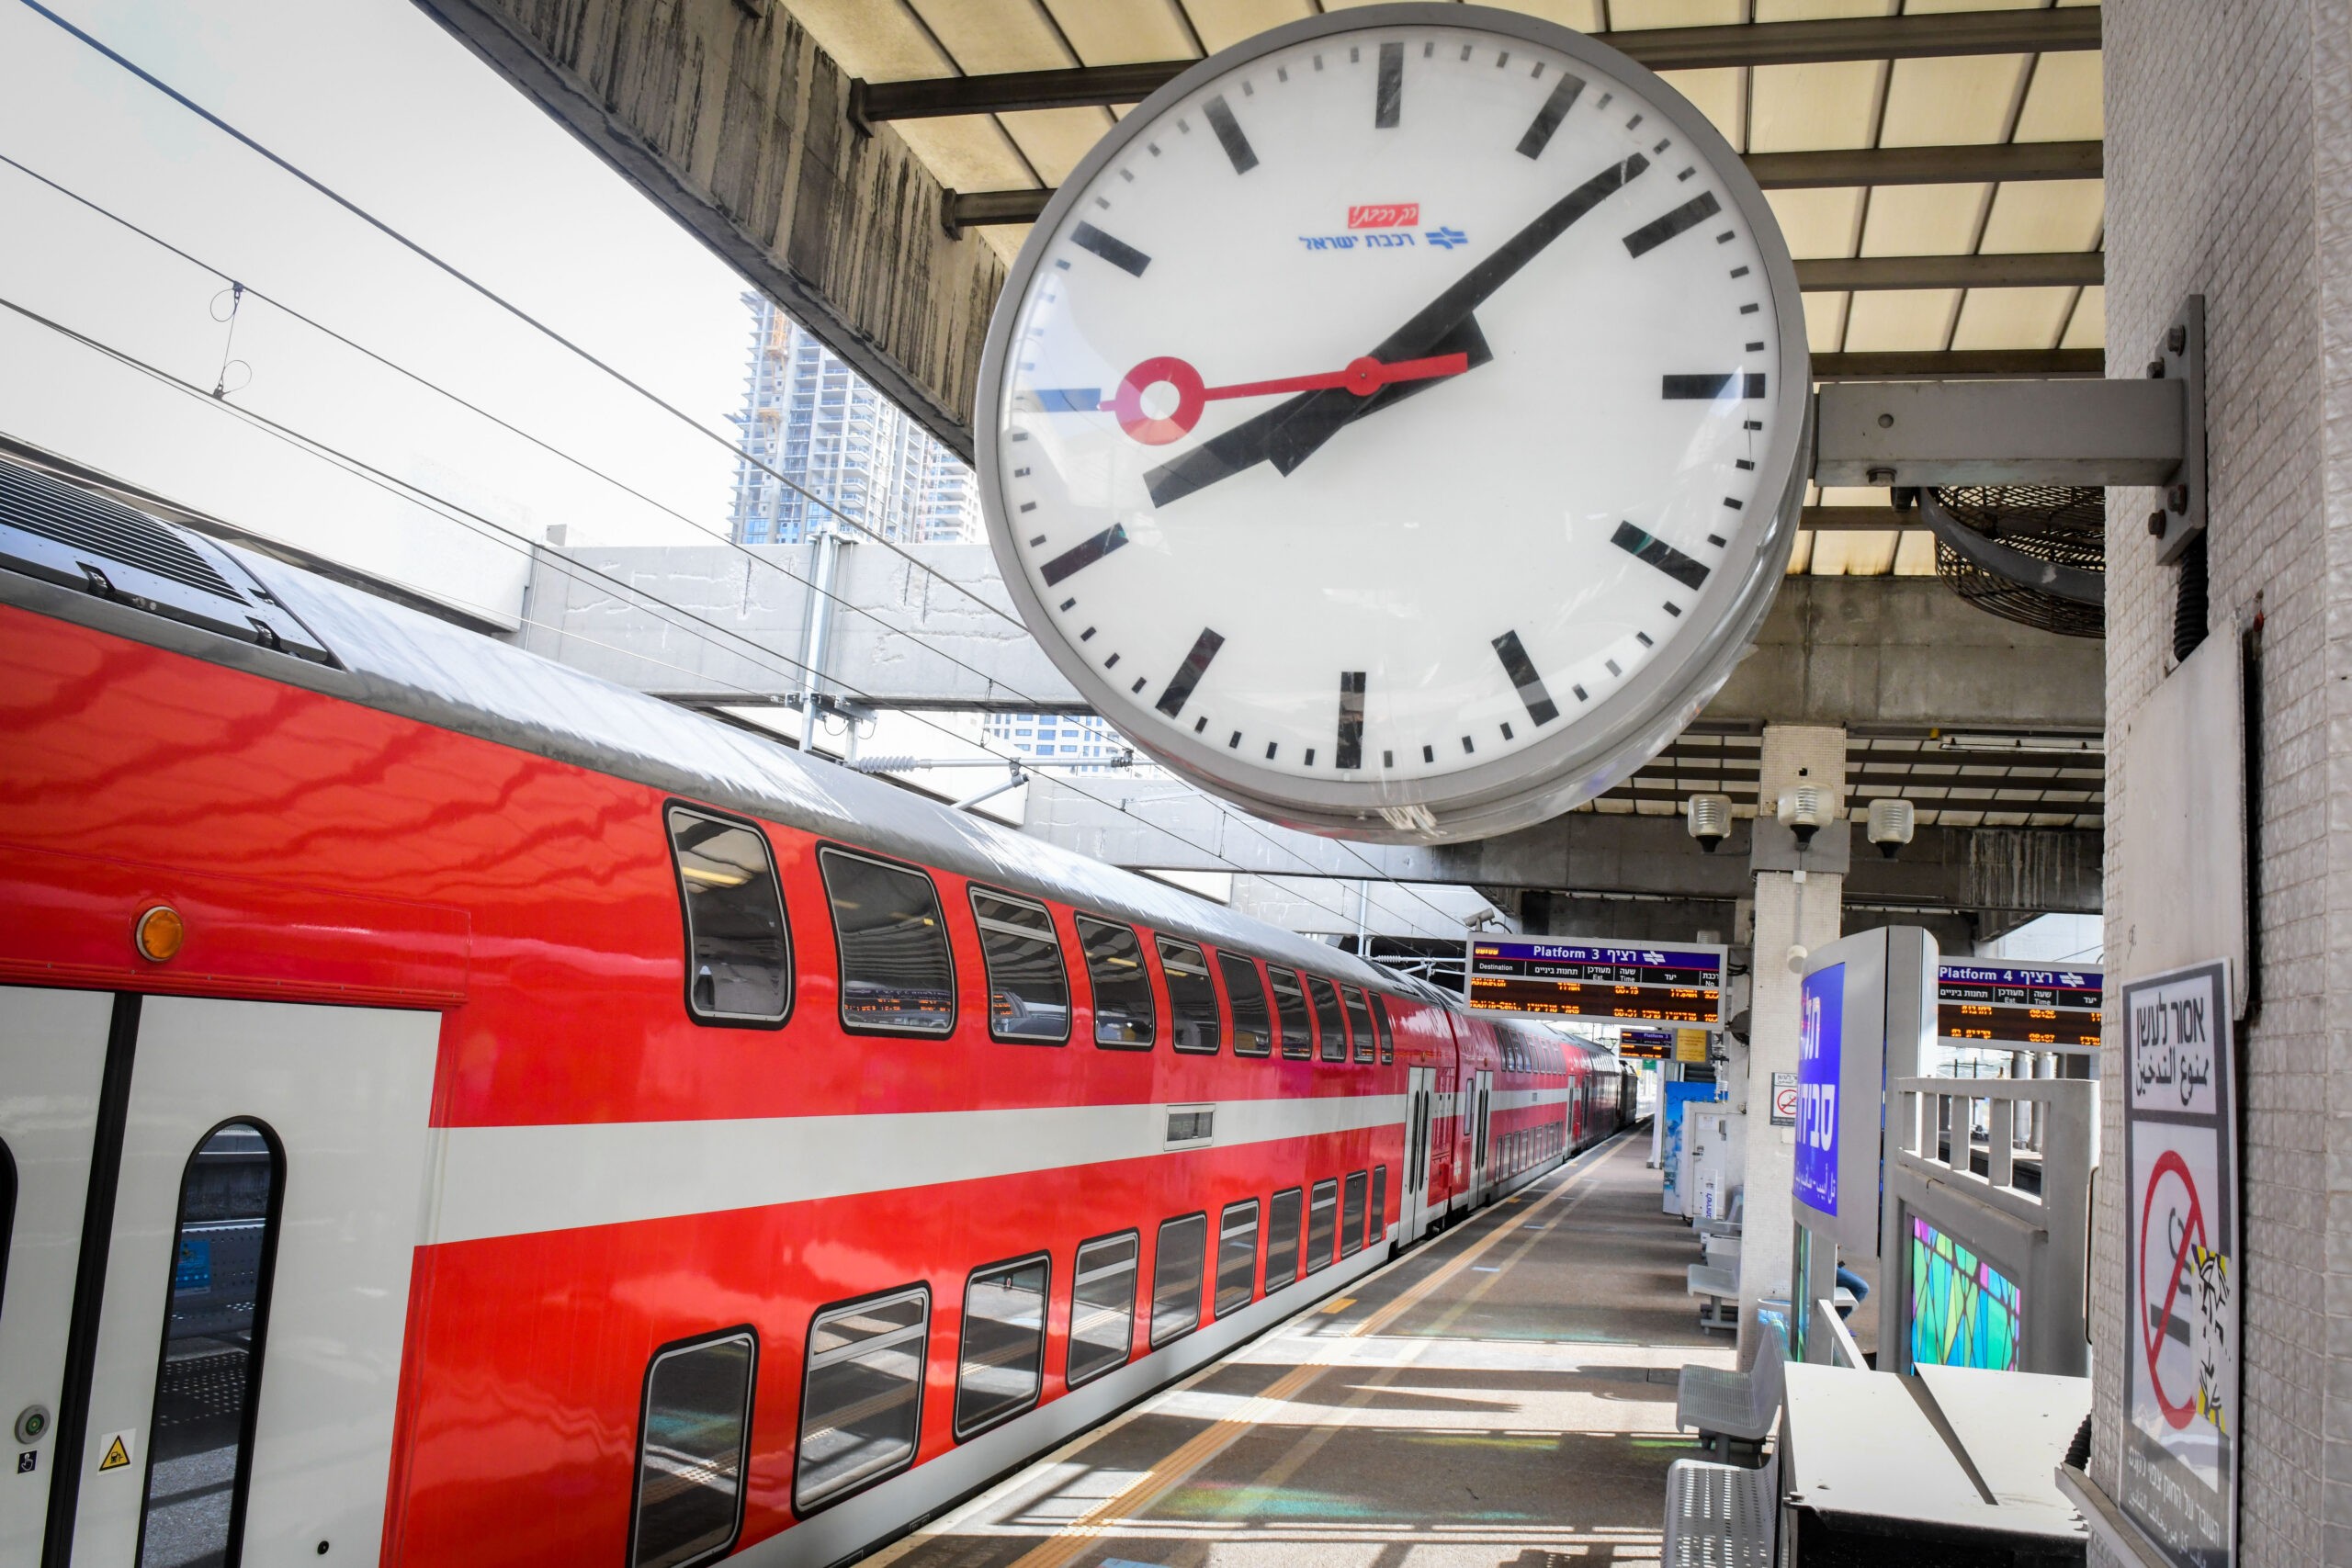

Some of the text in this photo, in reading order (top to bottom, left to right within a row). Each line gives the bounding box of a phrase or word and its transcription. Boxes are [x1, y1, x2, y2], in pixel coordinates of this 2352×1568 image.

[1298, 232, 1416, 251] רכבת ישראל
[1533, 945, 1637, 963] Platform 3 רציף
[1479, 963, 1513, 971] Destination
[1620, 967, 1636, 976] שעה
[1939, 966, 2053, 985] Platform 4 רציף
[1620, 975, 1635, 983] Time
[2033, 990, 2052, 998] שעה
[2136, 991, 2206, 1060] אסור לעשן
[2135, 1045, 2210, 1107] ممنوع التدخين
[2163, 1473, 2182, 1510] החוק
[2183, 1484, 2194, 1521] על
[2196, 1503, 2220, 1548] העובר
